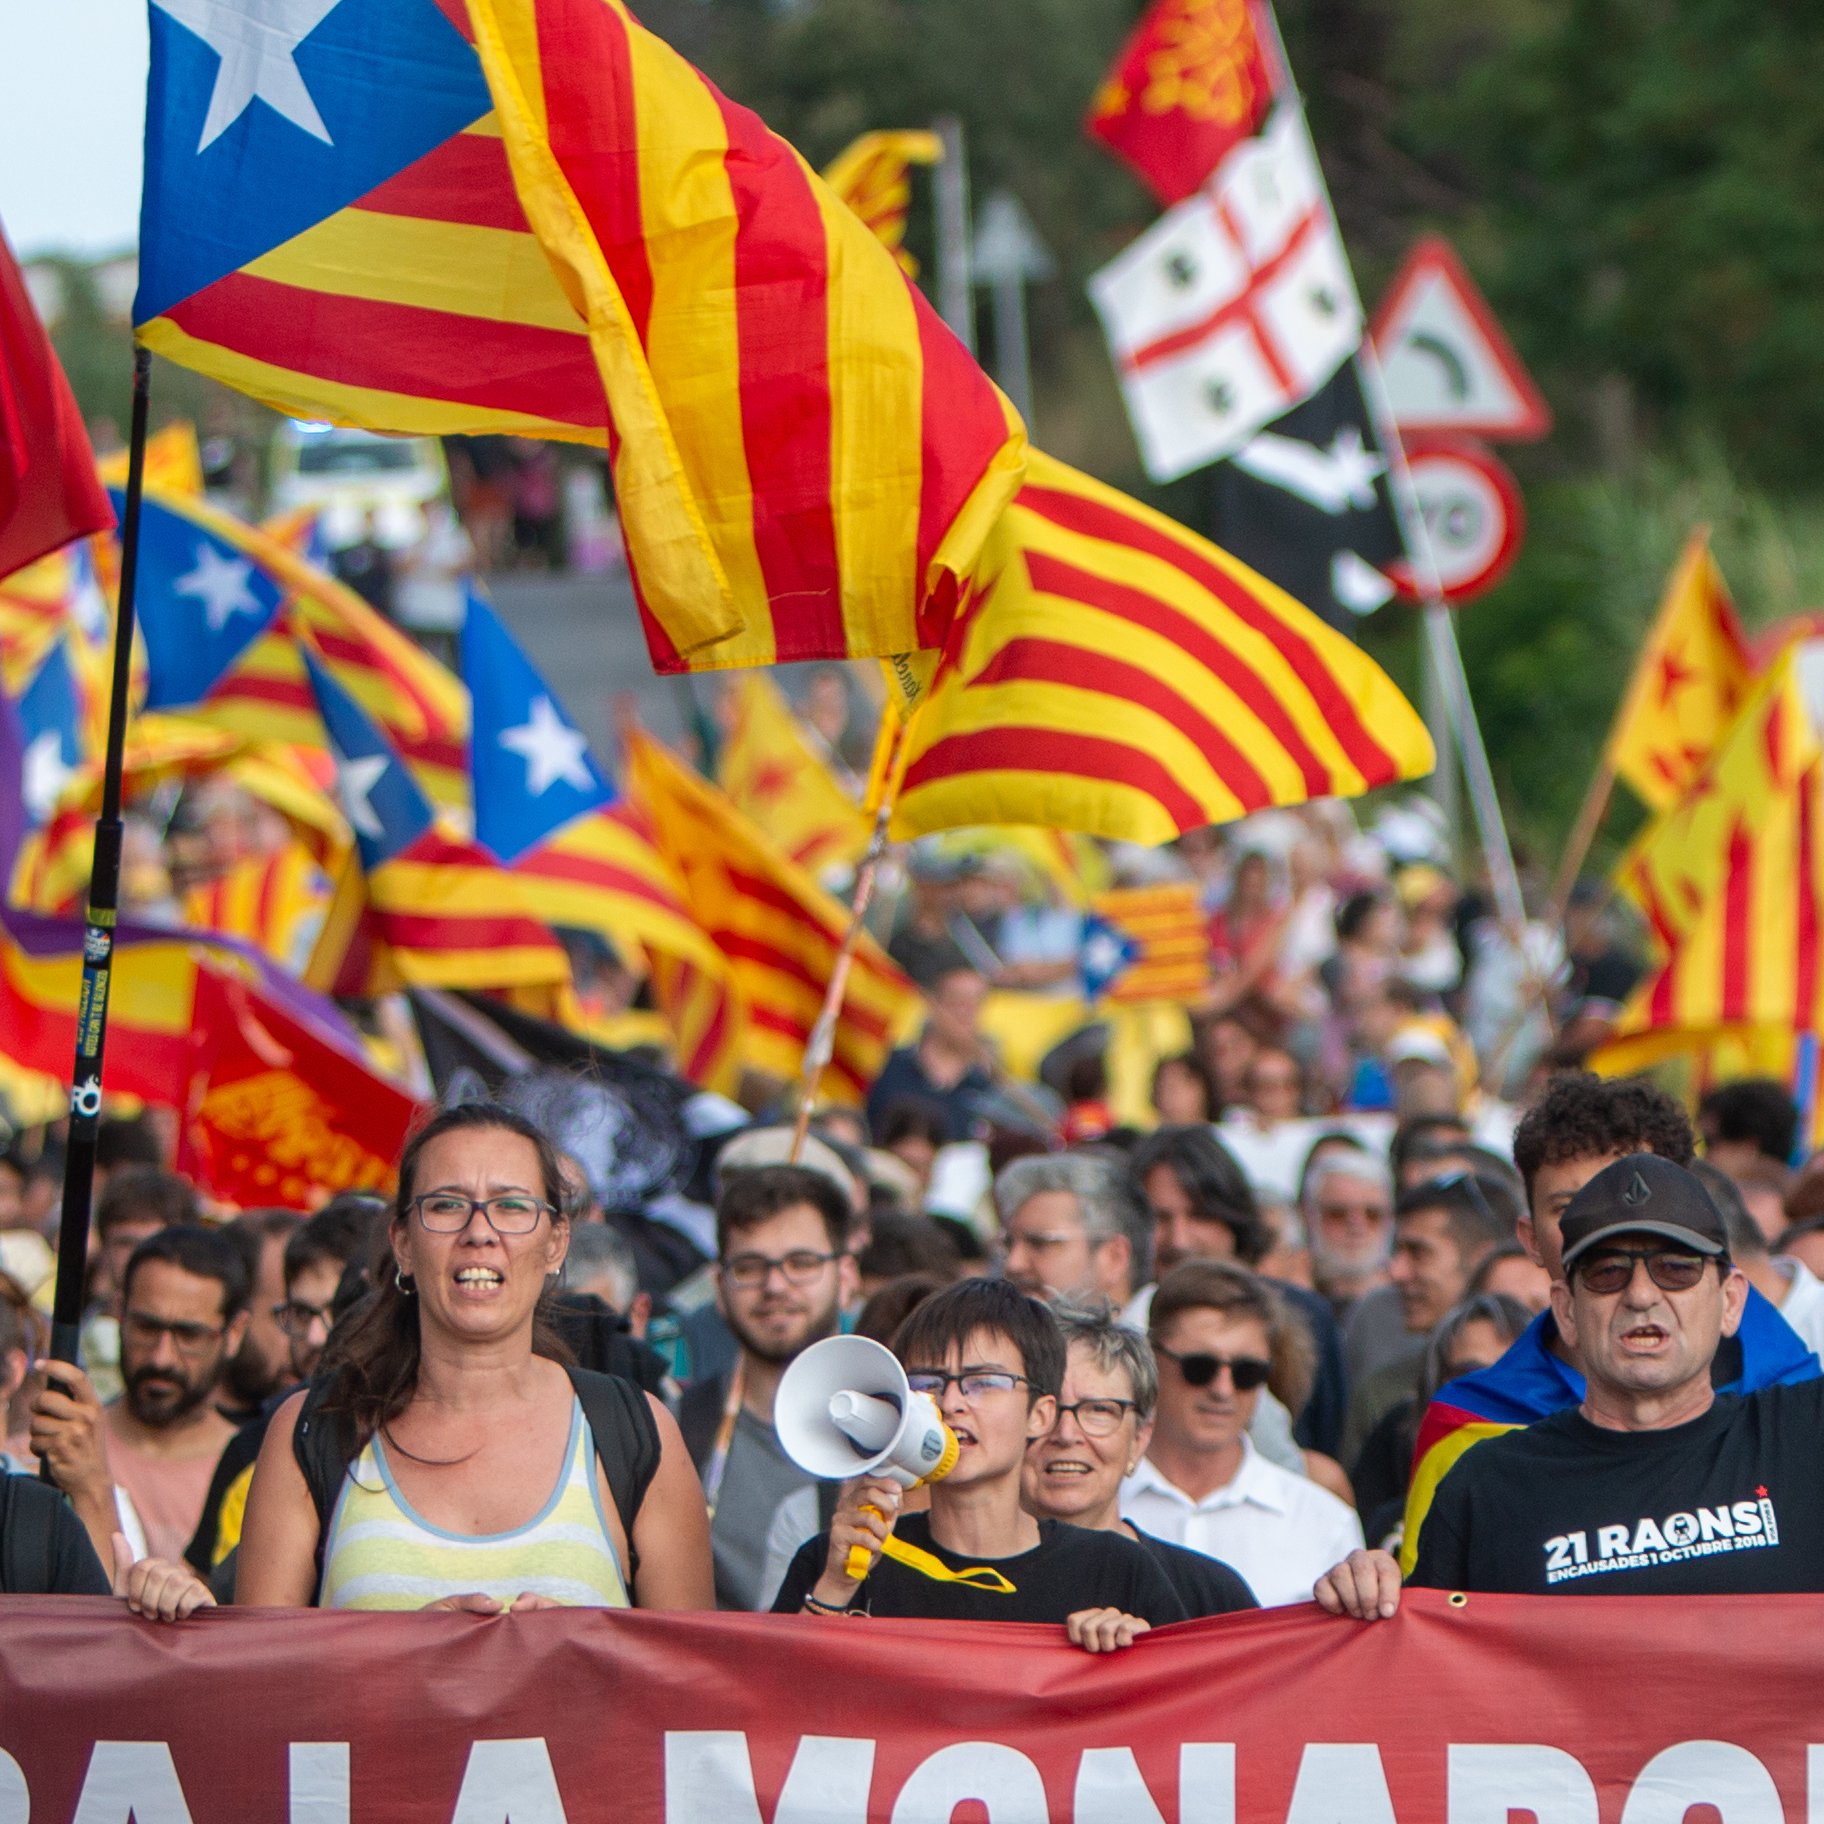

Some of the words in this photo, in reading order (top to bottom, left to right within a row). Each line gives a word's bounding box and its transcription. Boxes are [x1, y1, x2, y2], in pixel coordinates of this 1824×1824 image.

[1543, 1530, 1589, 1571] 21
[1547, 1554, 1650, 1584] ENCAUSADES
[1649, 1552, 1659, 1565] 1
[1660, 1538, 1734, 1563] OCTUBRE
[1734, 1533, 1766, 1551] 2018
